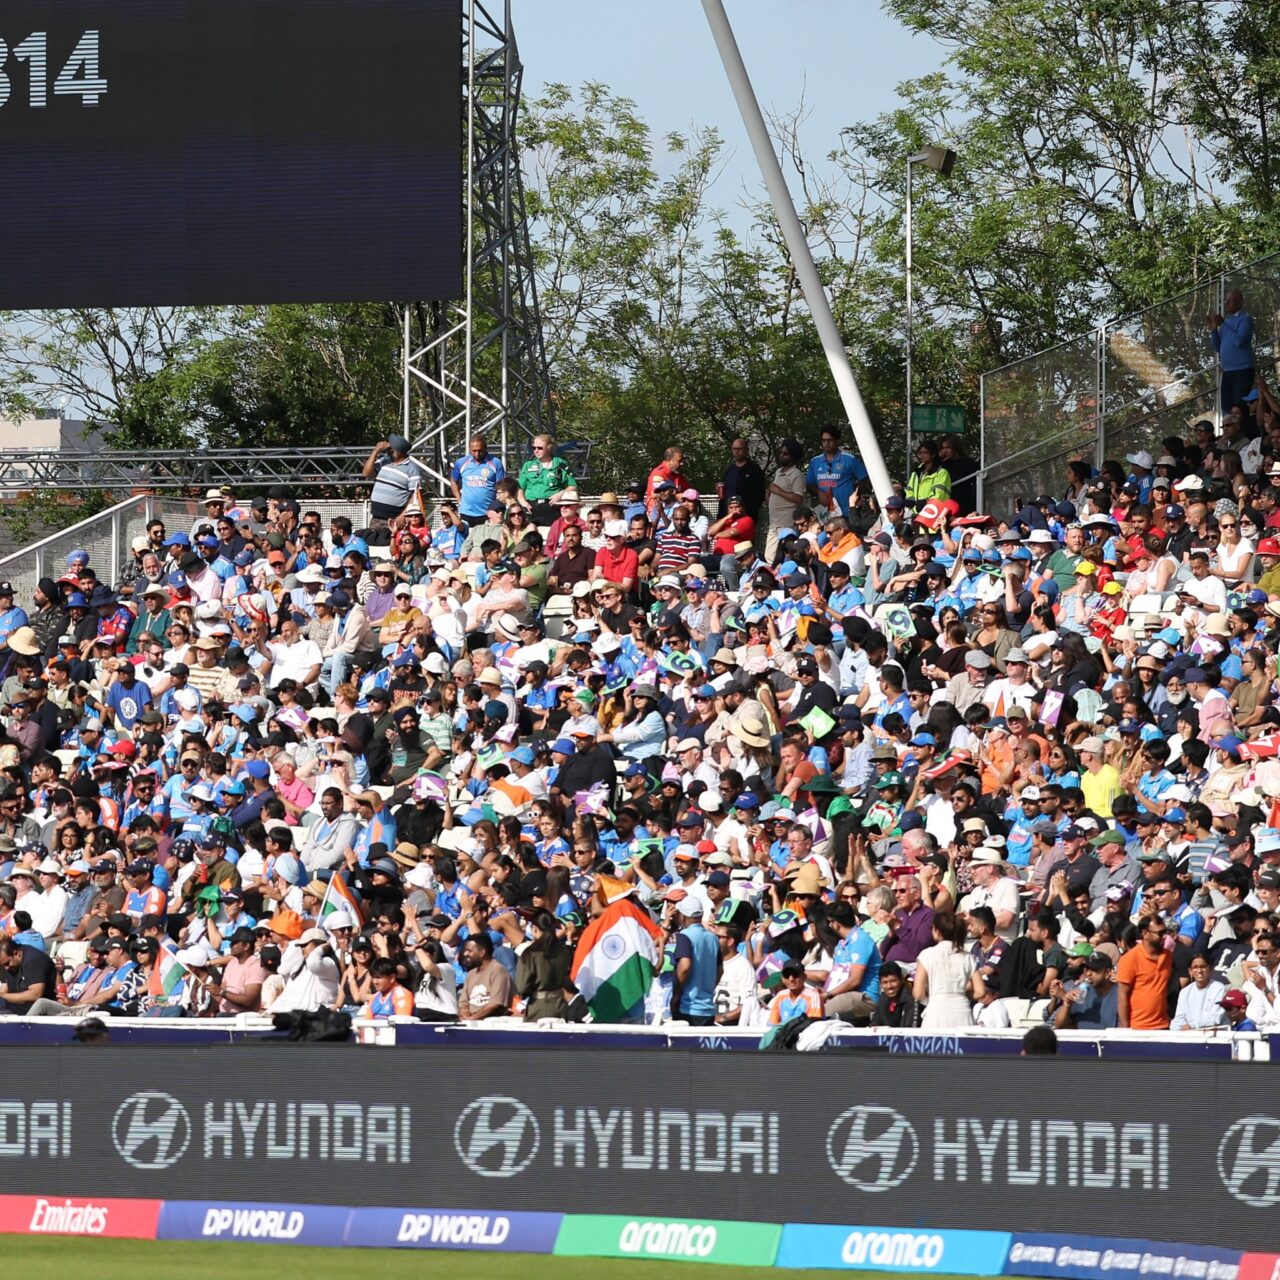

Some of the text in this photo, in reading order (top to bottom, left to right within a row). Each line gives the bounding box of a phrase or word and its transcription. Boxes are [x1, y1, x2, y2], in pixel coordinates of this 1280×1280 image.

[204, 1100, 411, 1163] HYUNDAI
[554, 1106, 779, 1174] HYUNDAI
[933, 1118, 1169, 1189] HYUNDAI
[29, 1199, 108, 1234] Emirates
[202, 1209, 304, 1239] DP WORLD
[397, 1214, 510, 1245] DP WORLD
[619, 1221, 717, 1256] aramco
[841, 1231, 944, 1267] aramco
